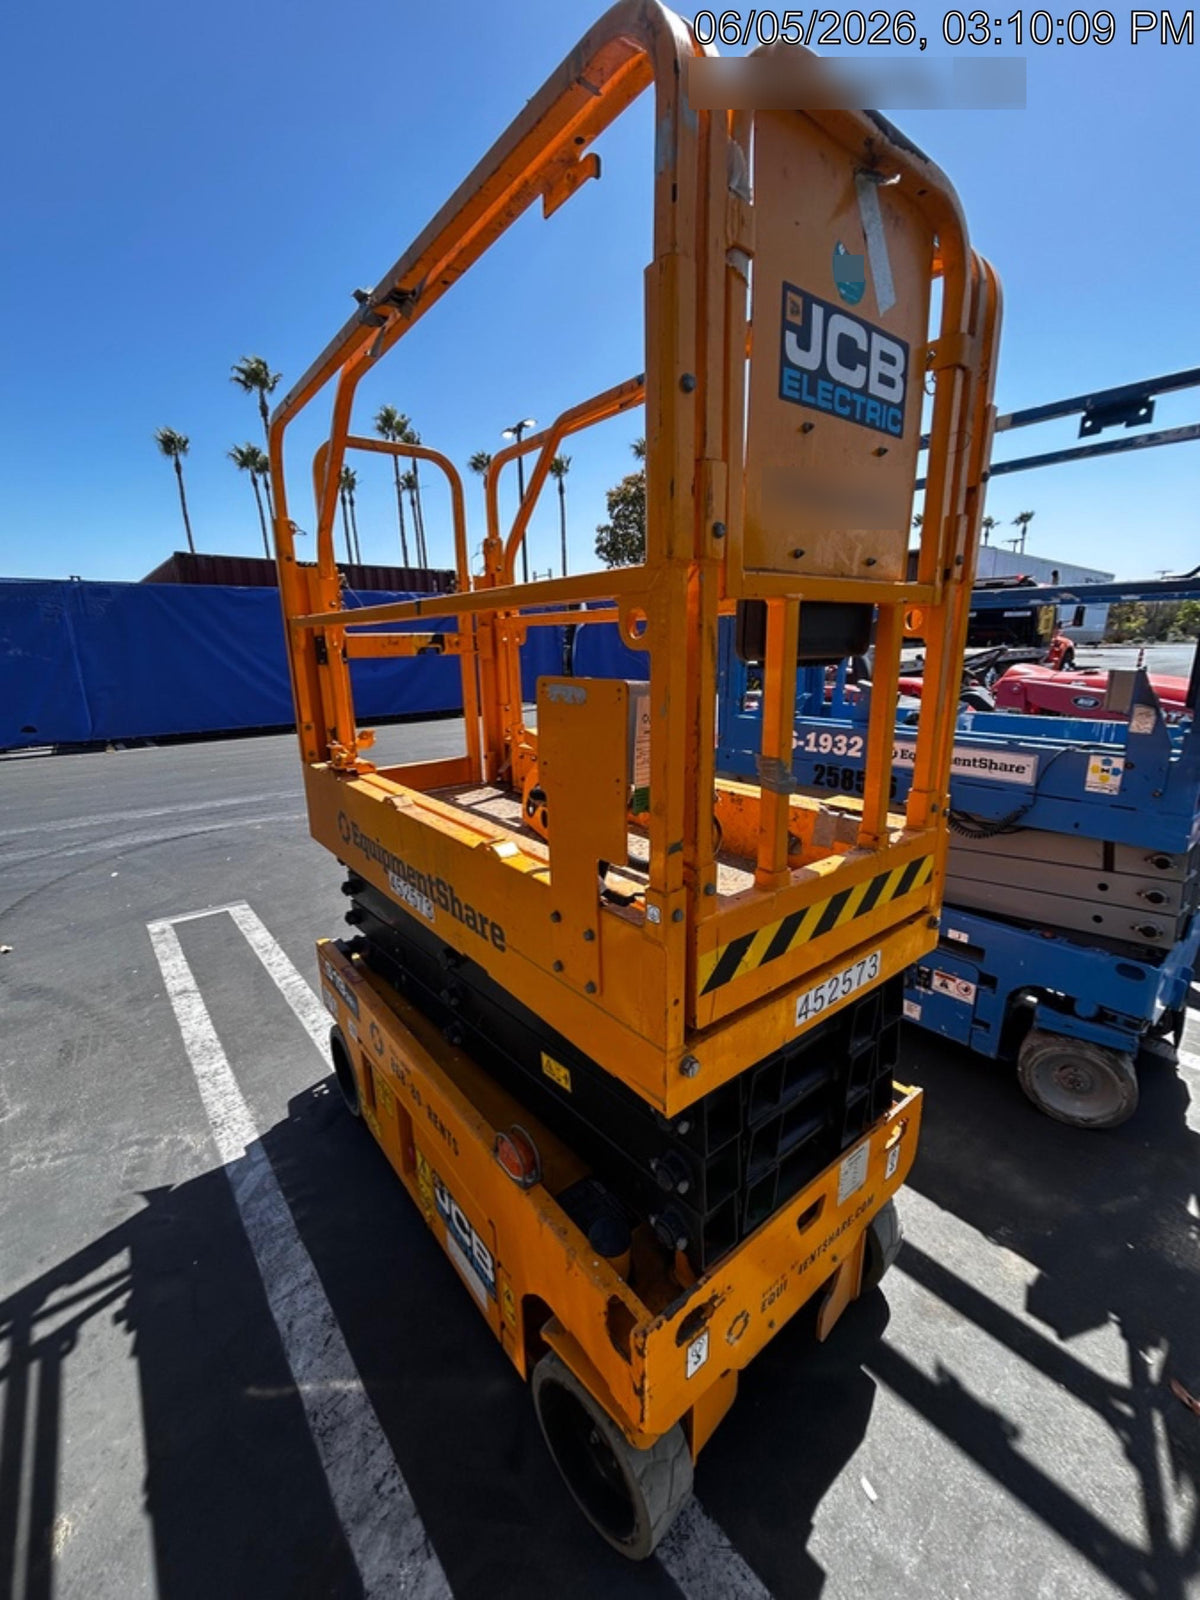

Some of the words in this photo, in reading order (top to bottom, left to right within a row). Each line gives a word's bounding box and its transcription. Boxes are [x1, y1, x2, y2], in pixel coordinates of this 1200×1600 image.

[785, 303, 906, 405] JCB
[783, 367, 902, 434] ELECTRIC
[900, 749, 1027, 775] EqentShare
[351, 820, 507, 953] EquipmentShare
[797, 953, 879, 1020] 452573
[434, 1186, 496, 1283] JCB
